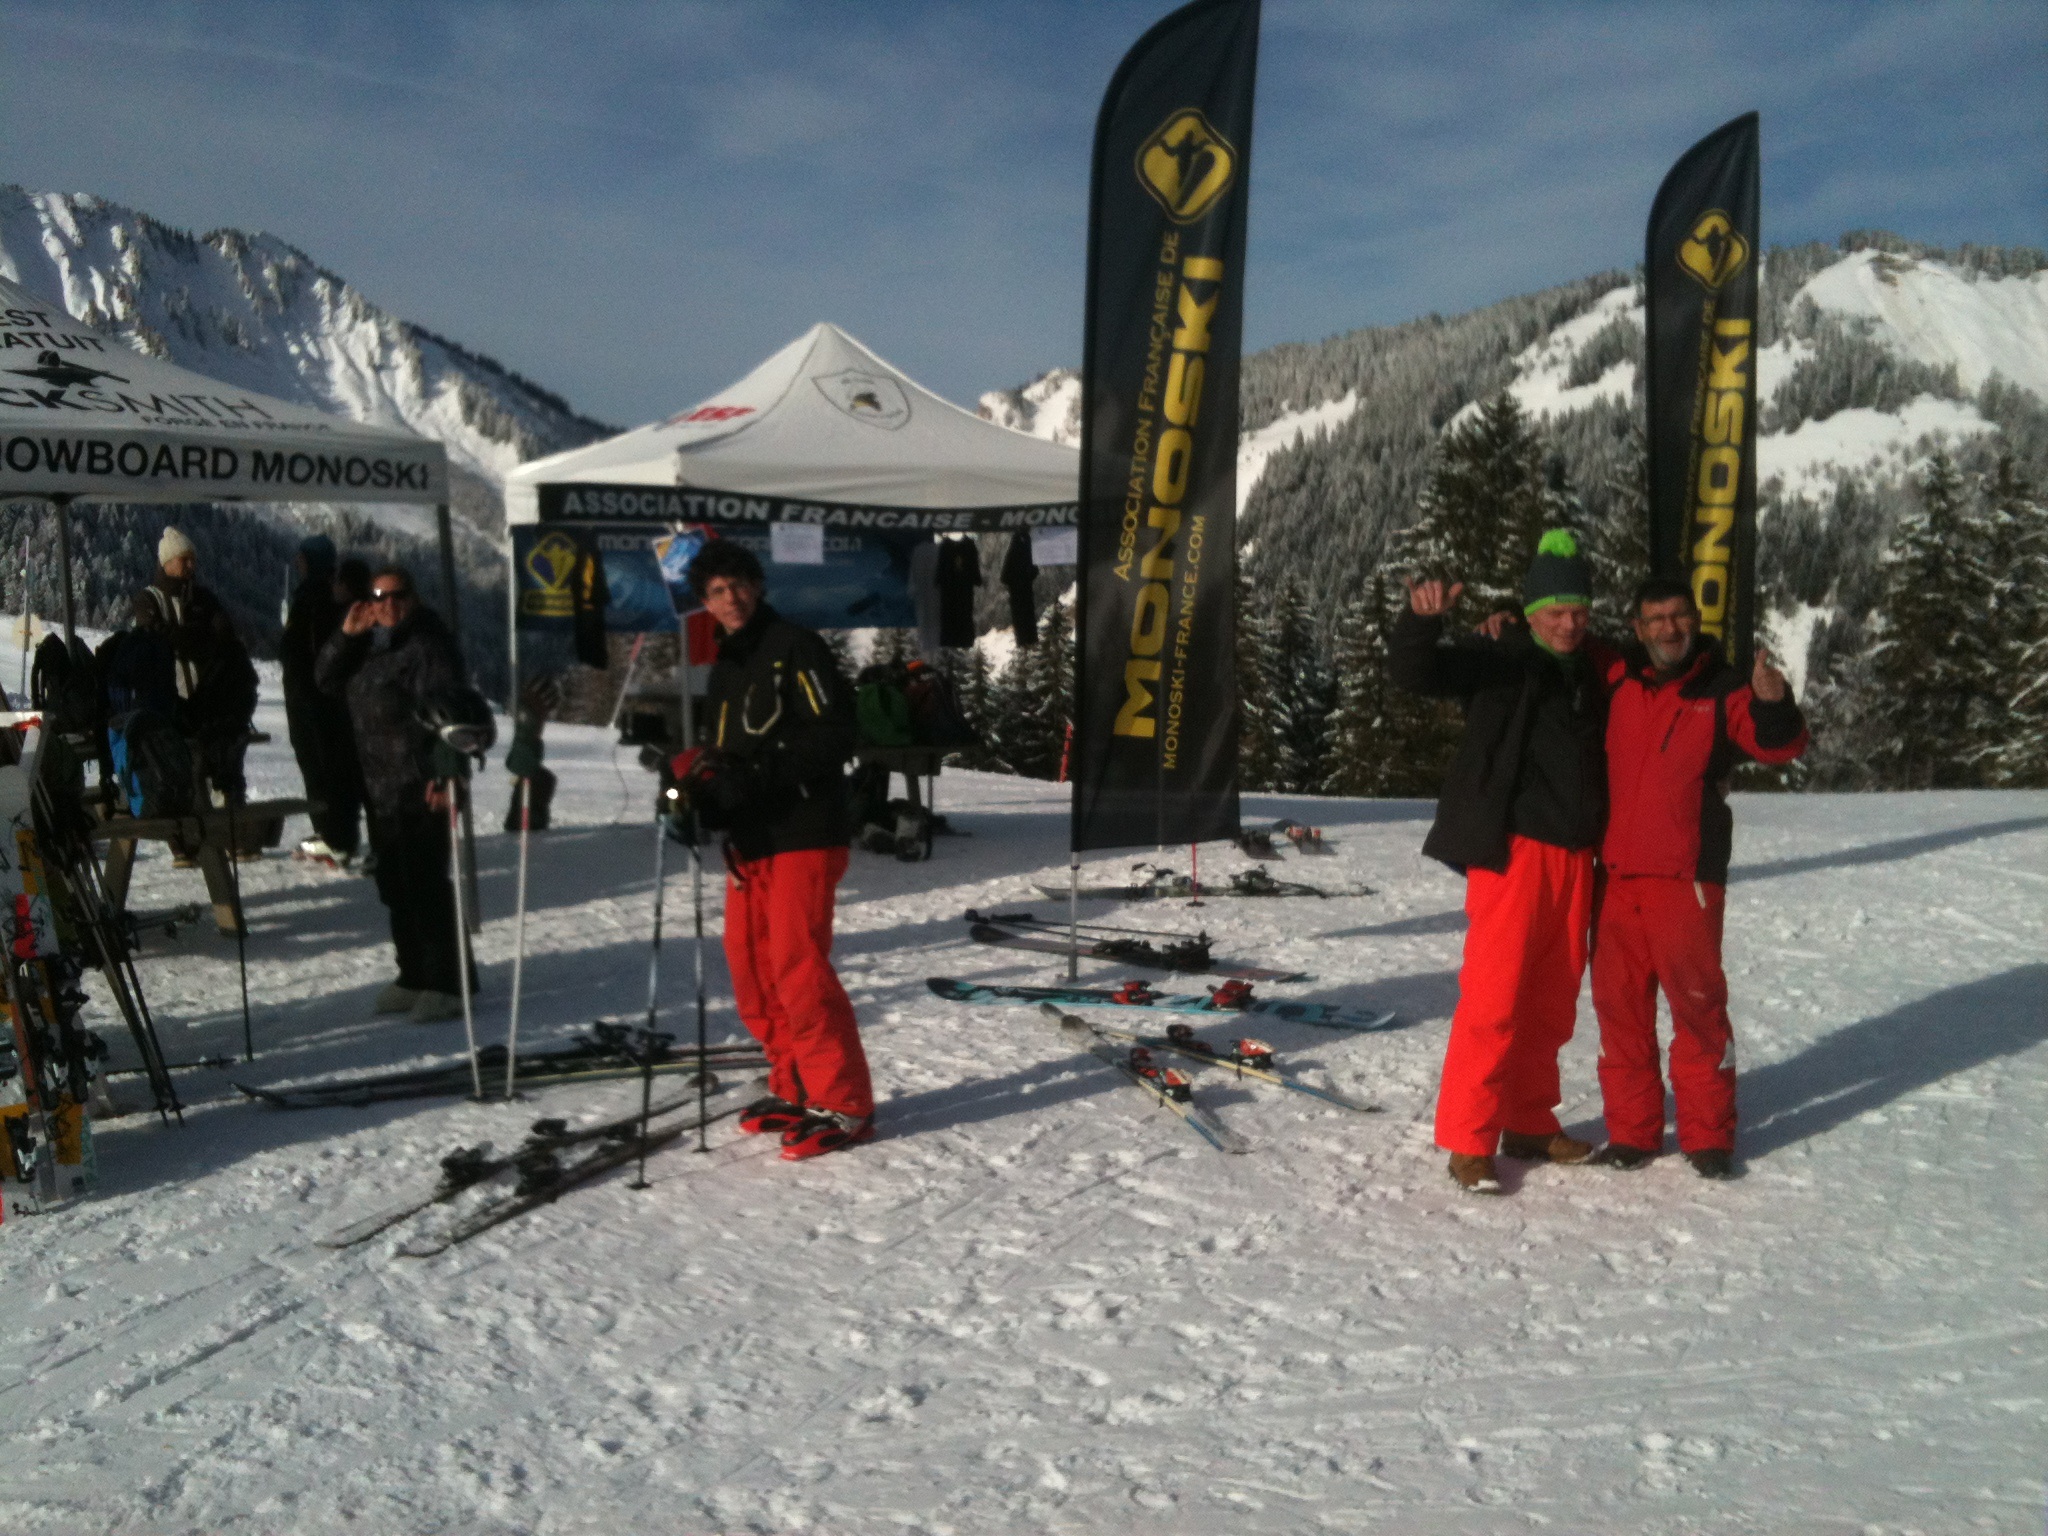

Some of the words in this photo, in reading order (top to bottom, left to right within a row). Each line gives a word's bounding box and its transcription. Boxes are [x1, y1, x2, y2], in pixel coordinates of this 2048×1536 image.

[0, 332, 104, 351] ATUIT
[0, 436, 239, 481] OWBOARD
[251, 450, 429, 490] MONOSKI
[1113, 418, 1153, 581] ASSOCIATION
[1138, 271, 1175, 412] FRANÇAISE
[1161, 231, 1180, 264] DE
[563, 490, 770, 520] ASSOCIATION
[780, 503, 975, 529] FRANCAISE
[1113, 256, 1223, 737] MONOSKI
[1691, 319, 1750, 639] ONOSKI
[1163, 515, 1205, 770] MONOSKI-FRANCE.COM
